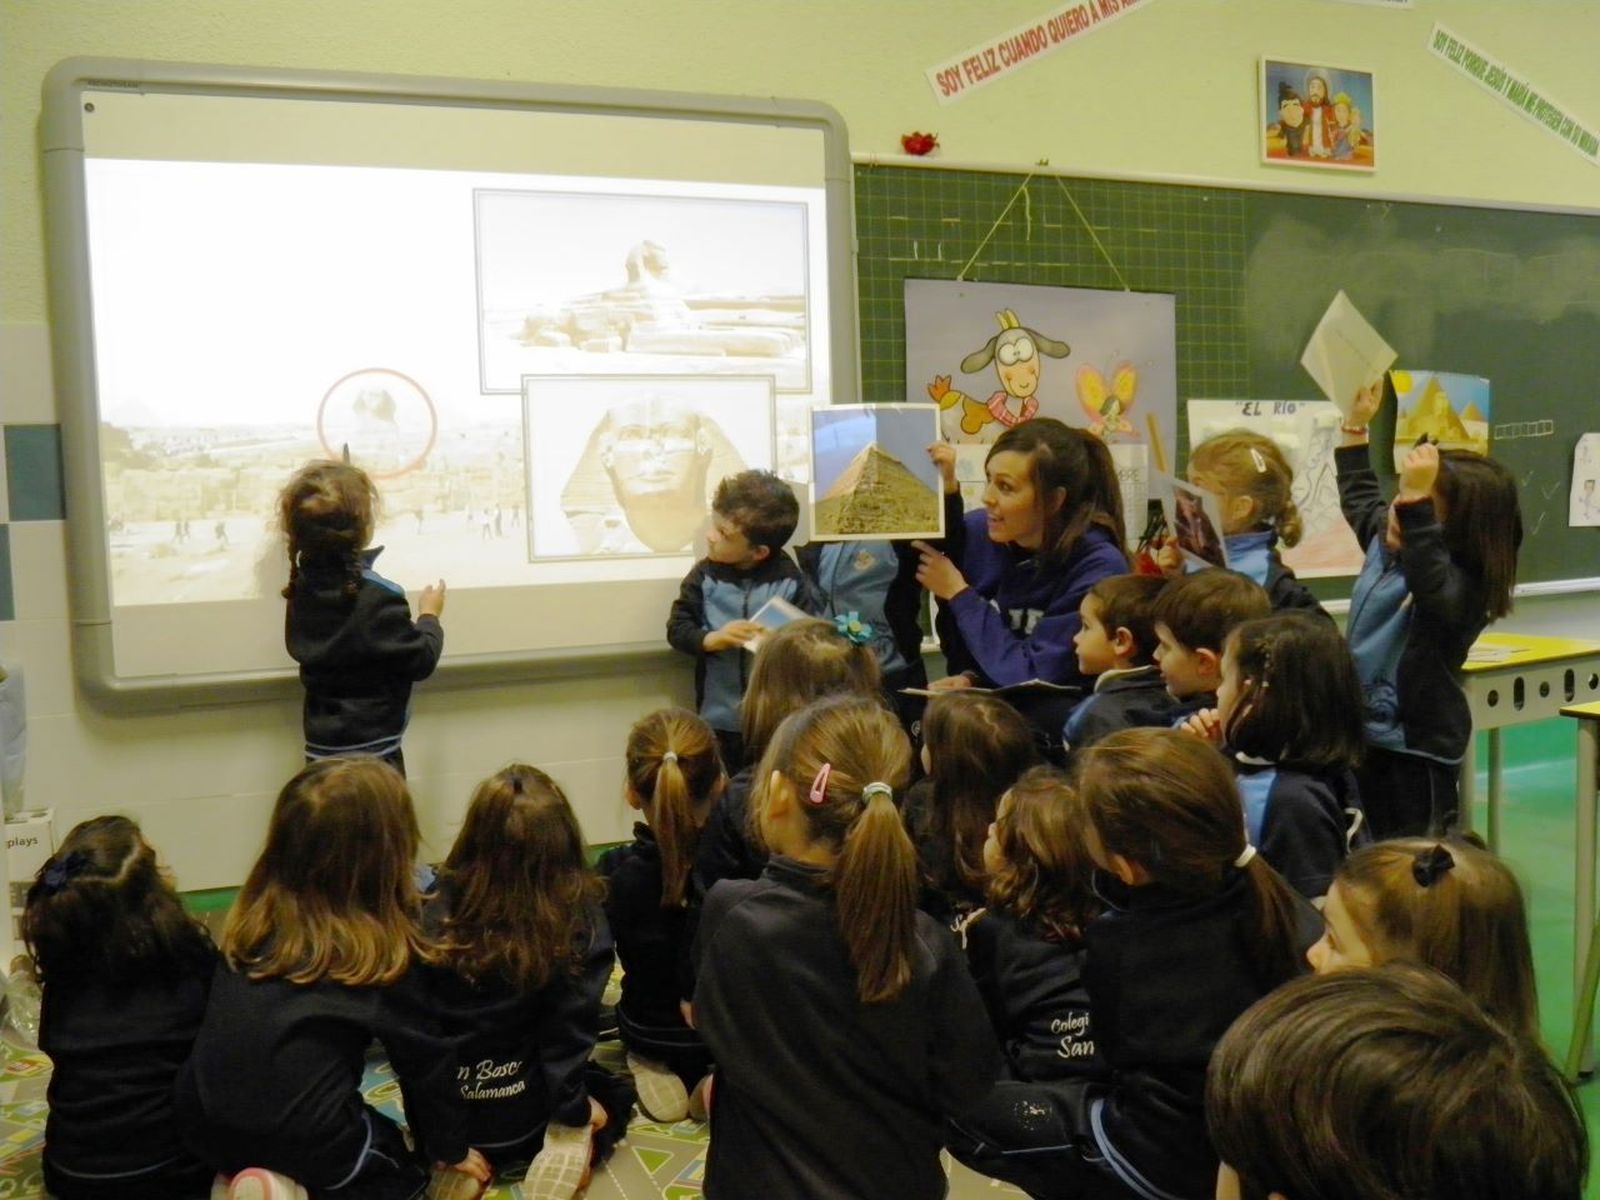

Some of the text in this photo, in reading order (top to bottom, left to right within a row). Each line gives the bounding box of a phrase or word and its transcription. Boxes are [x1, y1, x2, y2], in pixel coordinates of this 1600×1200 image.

[936, 65, 966, 97] SOY
[962, 47, 1001, 85] FELIZ
[998, 25, 1049, 67] CUANDO
[1048, 4, 1090, 44] QUIERO
[1089, 0, 1101, 23] A
[6, 836, 38, 849] plays
[1051, 1011, 1090, 1036] Colegi
[1056, 1035, 1095, 1058] San
[460, 1080, 526, 1100] Salamanca
